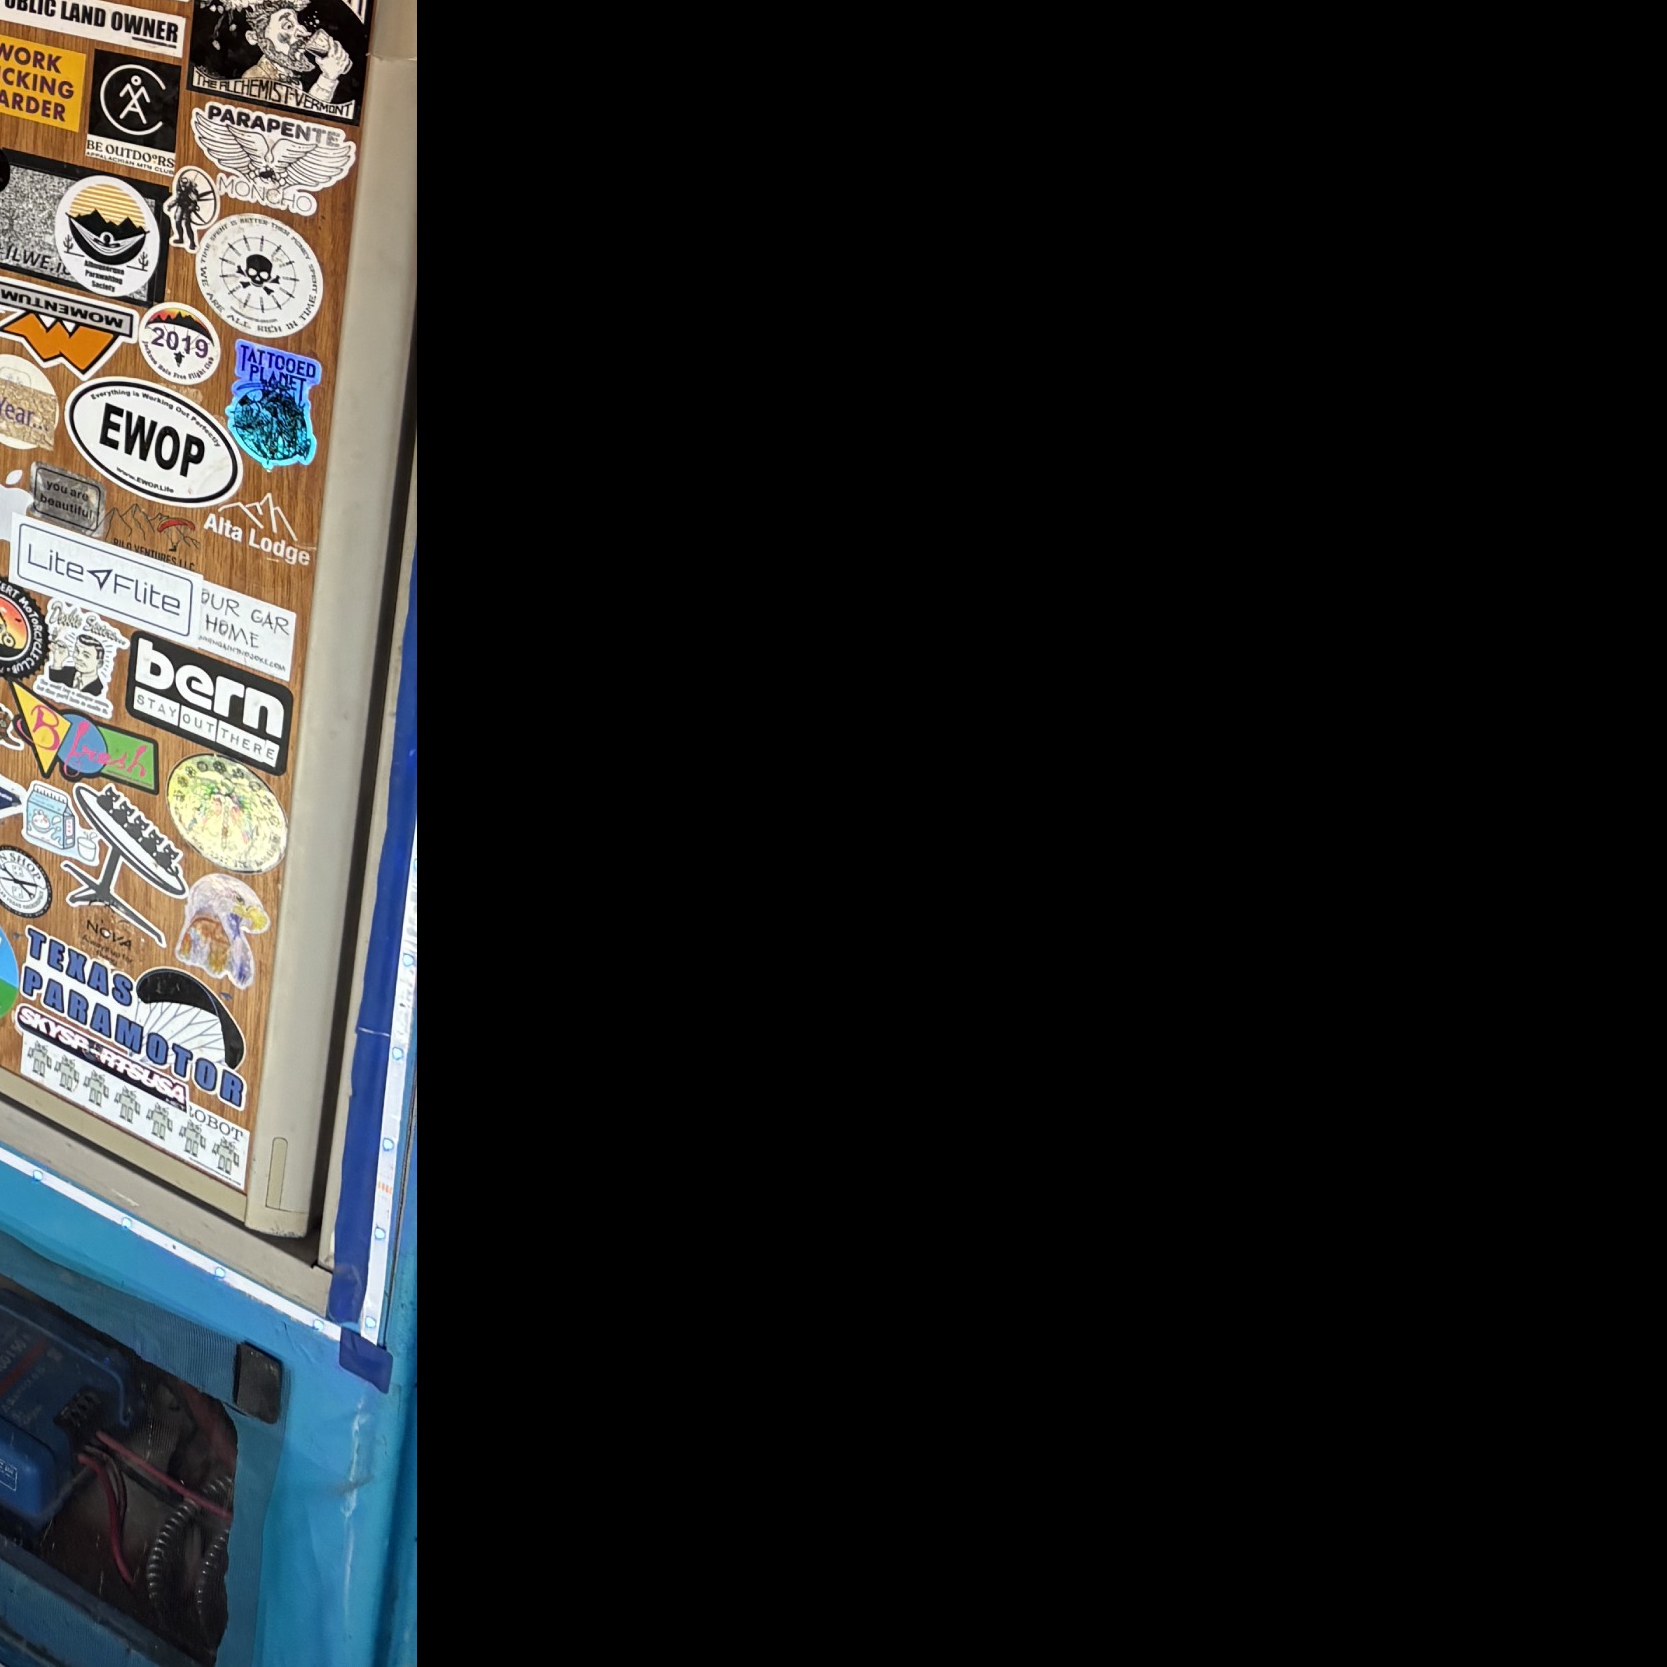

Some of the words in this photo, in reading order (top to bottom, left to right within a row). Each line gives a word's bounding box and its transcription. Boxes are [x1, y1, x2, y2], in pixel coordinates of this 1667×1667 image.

[109, 12, 179, 43] OWNER
[207, 105, 341, 148] PARAPENTE
[87, 140, 103, 153] BE
[106, 143, 175, 169] OUTDOORS
[151, 327, 208, 358] 2019
[91, 389, 131, 400] Everything
[142, 392, 174, 410] Working
[176, 407, 189, 418] Out
[191, 416, 221, 448] Perfectly
[99, 402, 205, 478] EWOP
[46, 479, 65, 494] you
[67, 488, 89, 502] are
[204, 512, 243, 543] Alta
[248, 532, 311, 566] Lodge
[19, 597, 43, 660] MOTORCYCLE
[12, 658, 35, 673] CLUB
[135, 637, 285, 739] bern
[27, 927, 134, 1007] TEXAS
[22, 966, 245, 1108] PARAMOTOR
